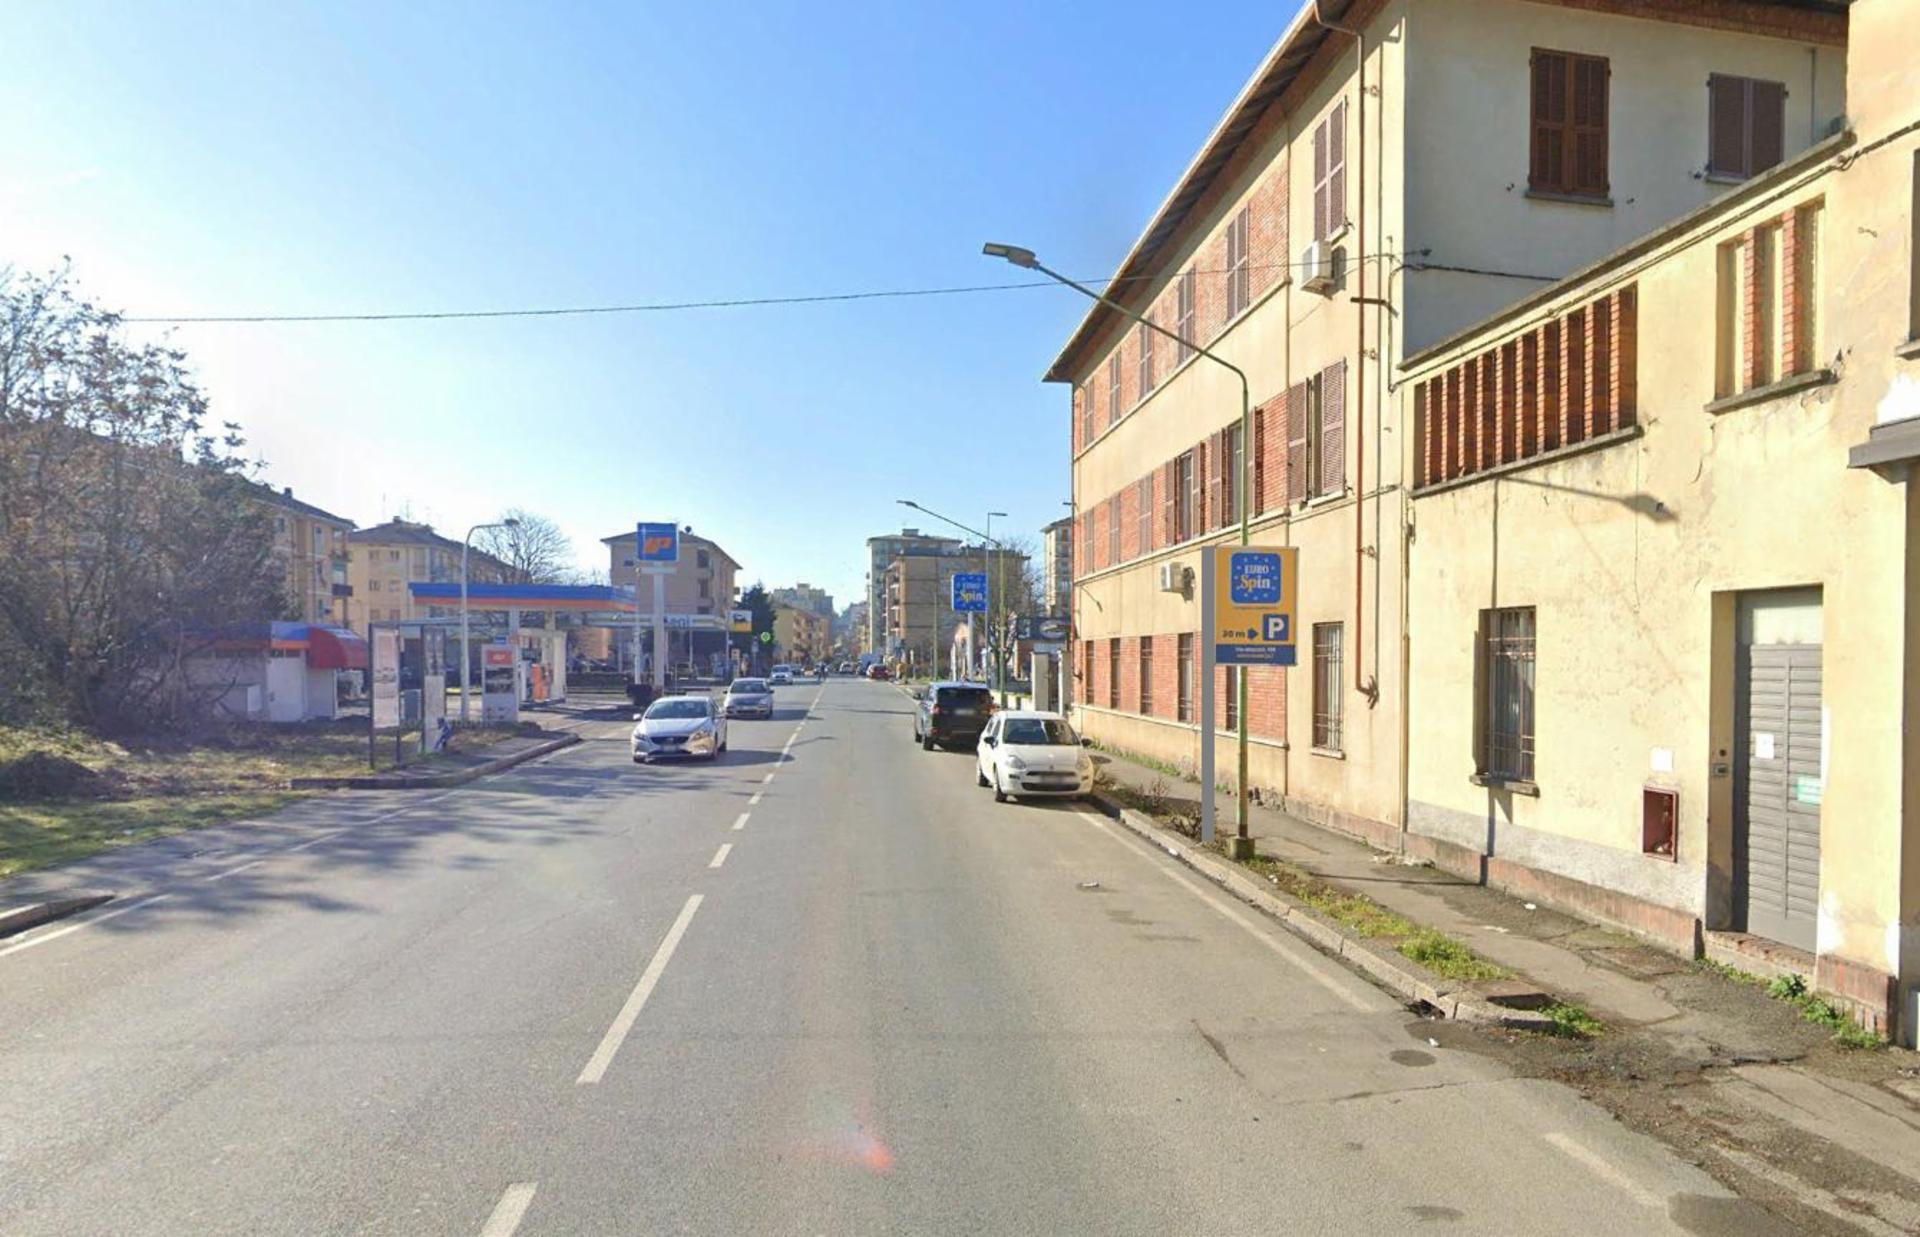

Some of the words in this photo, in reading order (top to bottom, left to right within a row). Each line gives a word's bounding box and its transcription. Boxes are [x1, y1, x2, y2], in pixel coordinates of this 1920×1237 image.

[1244, 564, 1270, 574] EURO
[1240, 574, 1271, 592] Spin
[1268, 617, 1285, 639] P
